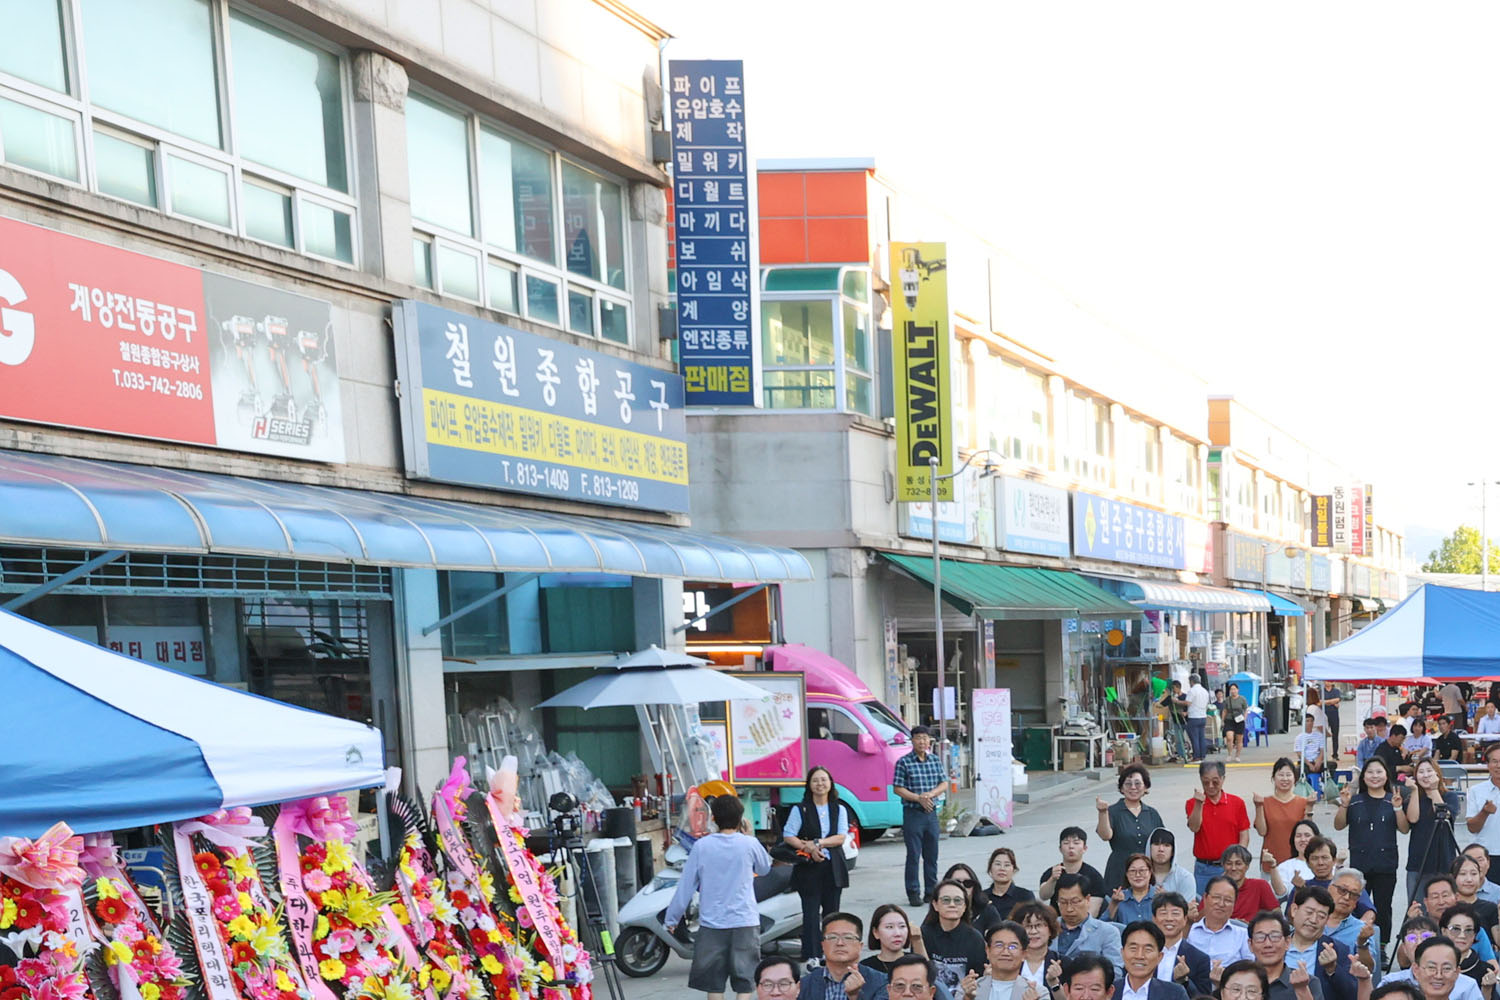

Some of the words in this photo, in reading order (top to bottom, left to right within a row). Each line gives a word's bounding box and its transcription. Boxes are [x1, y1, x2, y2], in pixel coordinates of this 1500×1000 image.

[673, 75, 743, 97] 파이프
[675, 98, 743, 120] 유압호수
[676, 121, 744, 143] 제작
[677, 151, 744, 173] 밀워키
[678, 180, 745, 203] 디월트
[679, 211, 746, 233] 마끼다
[680, 241, 747, 263] 보쉬
[681, 270, 748, 292] 아임삭
[68, 281, 198, 344] 계양전동공구
[682, 300, 749, 322] 계양
[683, 328, 750, 351] 엔진종류
[118, 340, 201, 375] 철원종합공구상사
[112, 368, 203, 401] T.033-742-2806
[444, 320, 670, 433] 철원종합공구
[684, 364, 750, 394] 판매점
[907, 320, 939, 467] DEWALT
[270, 419, 311, 438] SERIES
[517, 462, 570, 492] 813-1409
[593, 475, 640, 501] 813-1209
[906, 487, 947, 497] 732-809
[1333, 486, 1345, 544] 동원펌프
[1101, 500, 1184, 557] 원주공구종합상사
[155, 640, 205, 663] 대리점
[502, 823, 533, 886] 중소기업
[183, 873, 228, 990] 한국폴리텍대학
[290, 897, 319, 983] 대한과학
